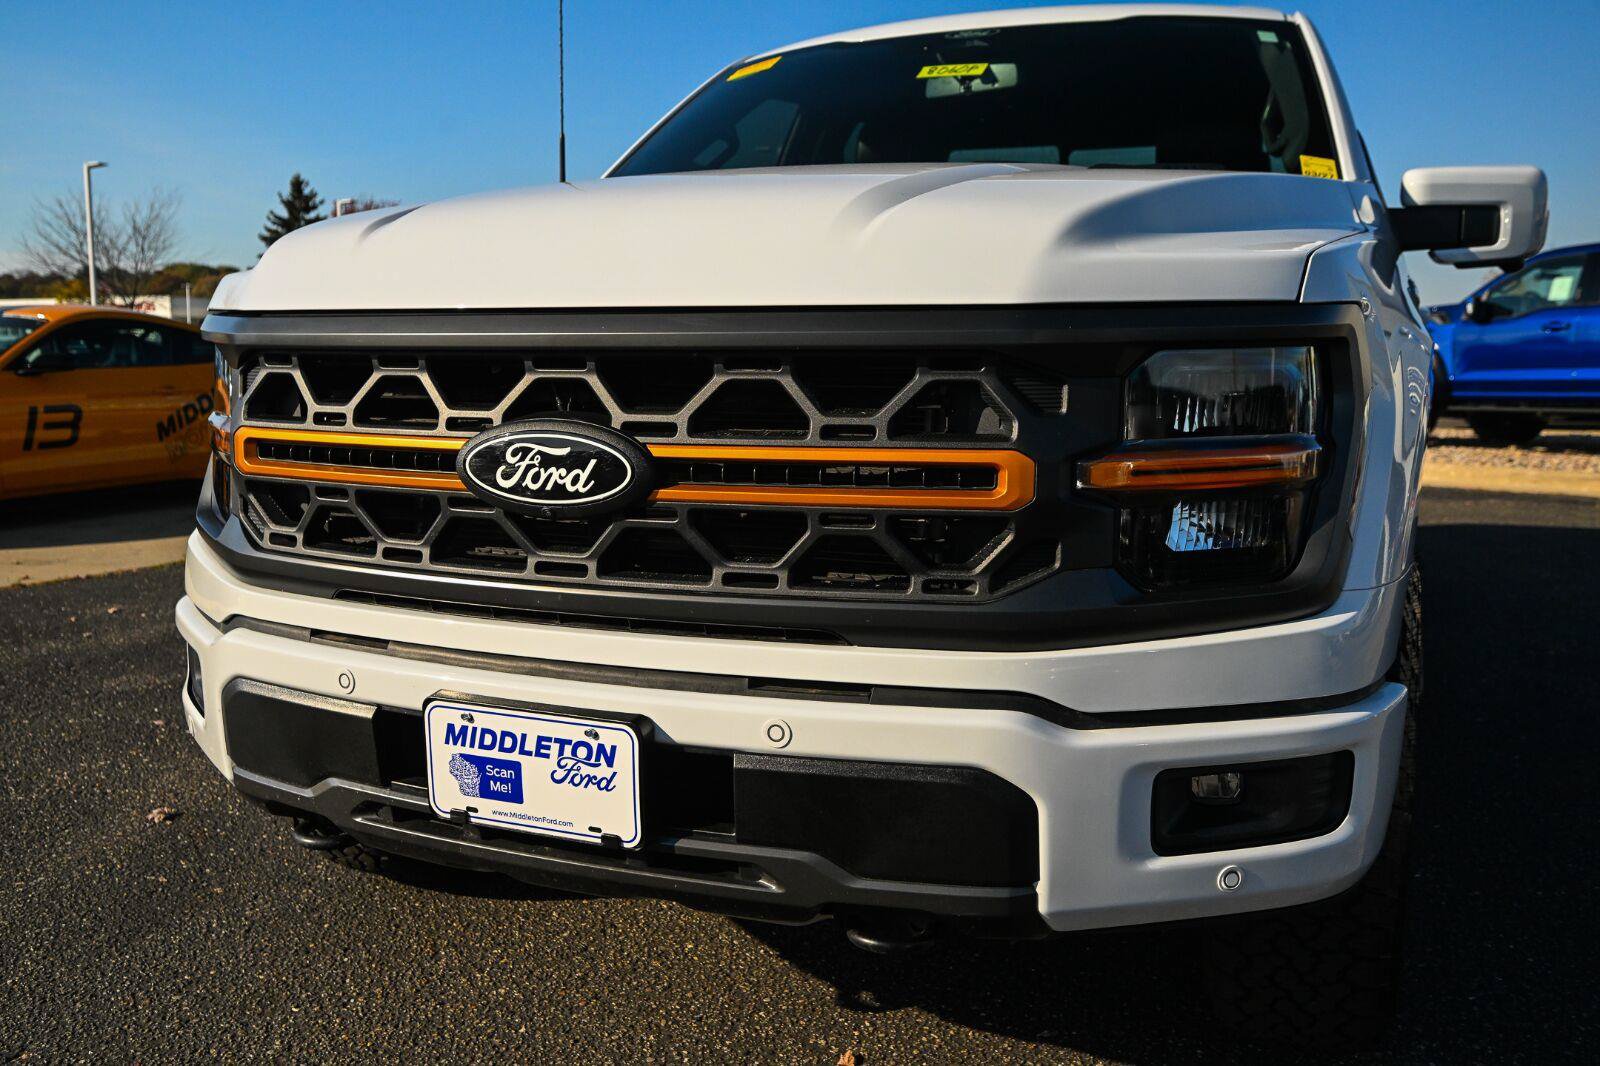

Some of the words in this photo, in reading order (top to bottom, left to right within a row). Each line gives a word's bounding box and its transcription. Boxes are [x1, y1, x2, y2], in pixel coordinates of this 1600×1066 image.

[22, 404, 83, 452] 13
[495, 443, 597, 493] Ford
[444, 723, 617, 768] MIDDLETON
[485, 764, 515, 780] Scan
[489, 781, 512, 795] Me!
[550, 756, 618, 793] Ford
[492, 810, 574, 828] www.MiddletonFord.com
